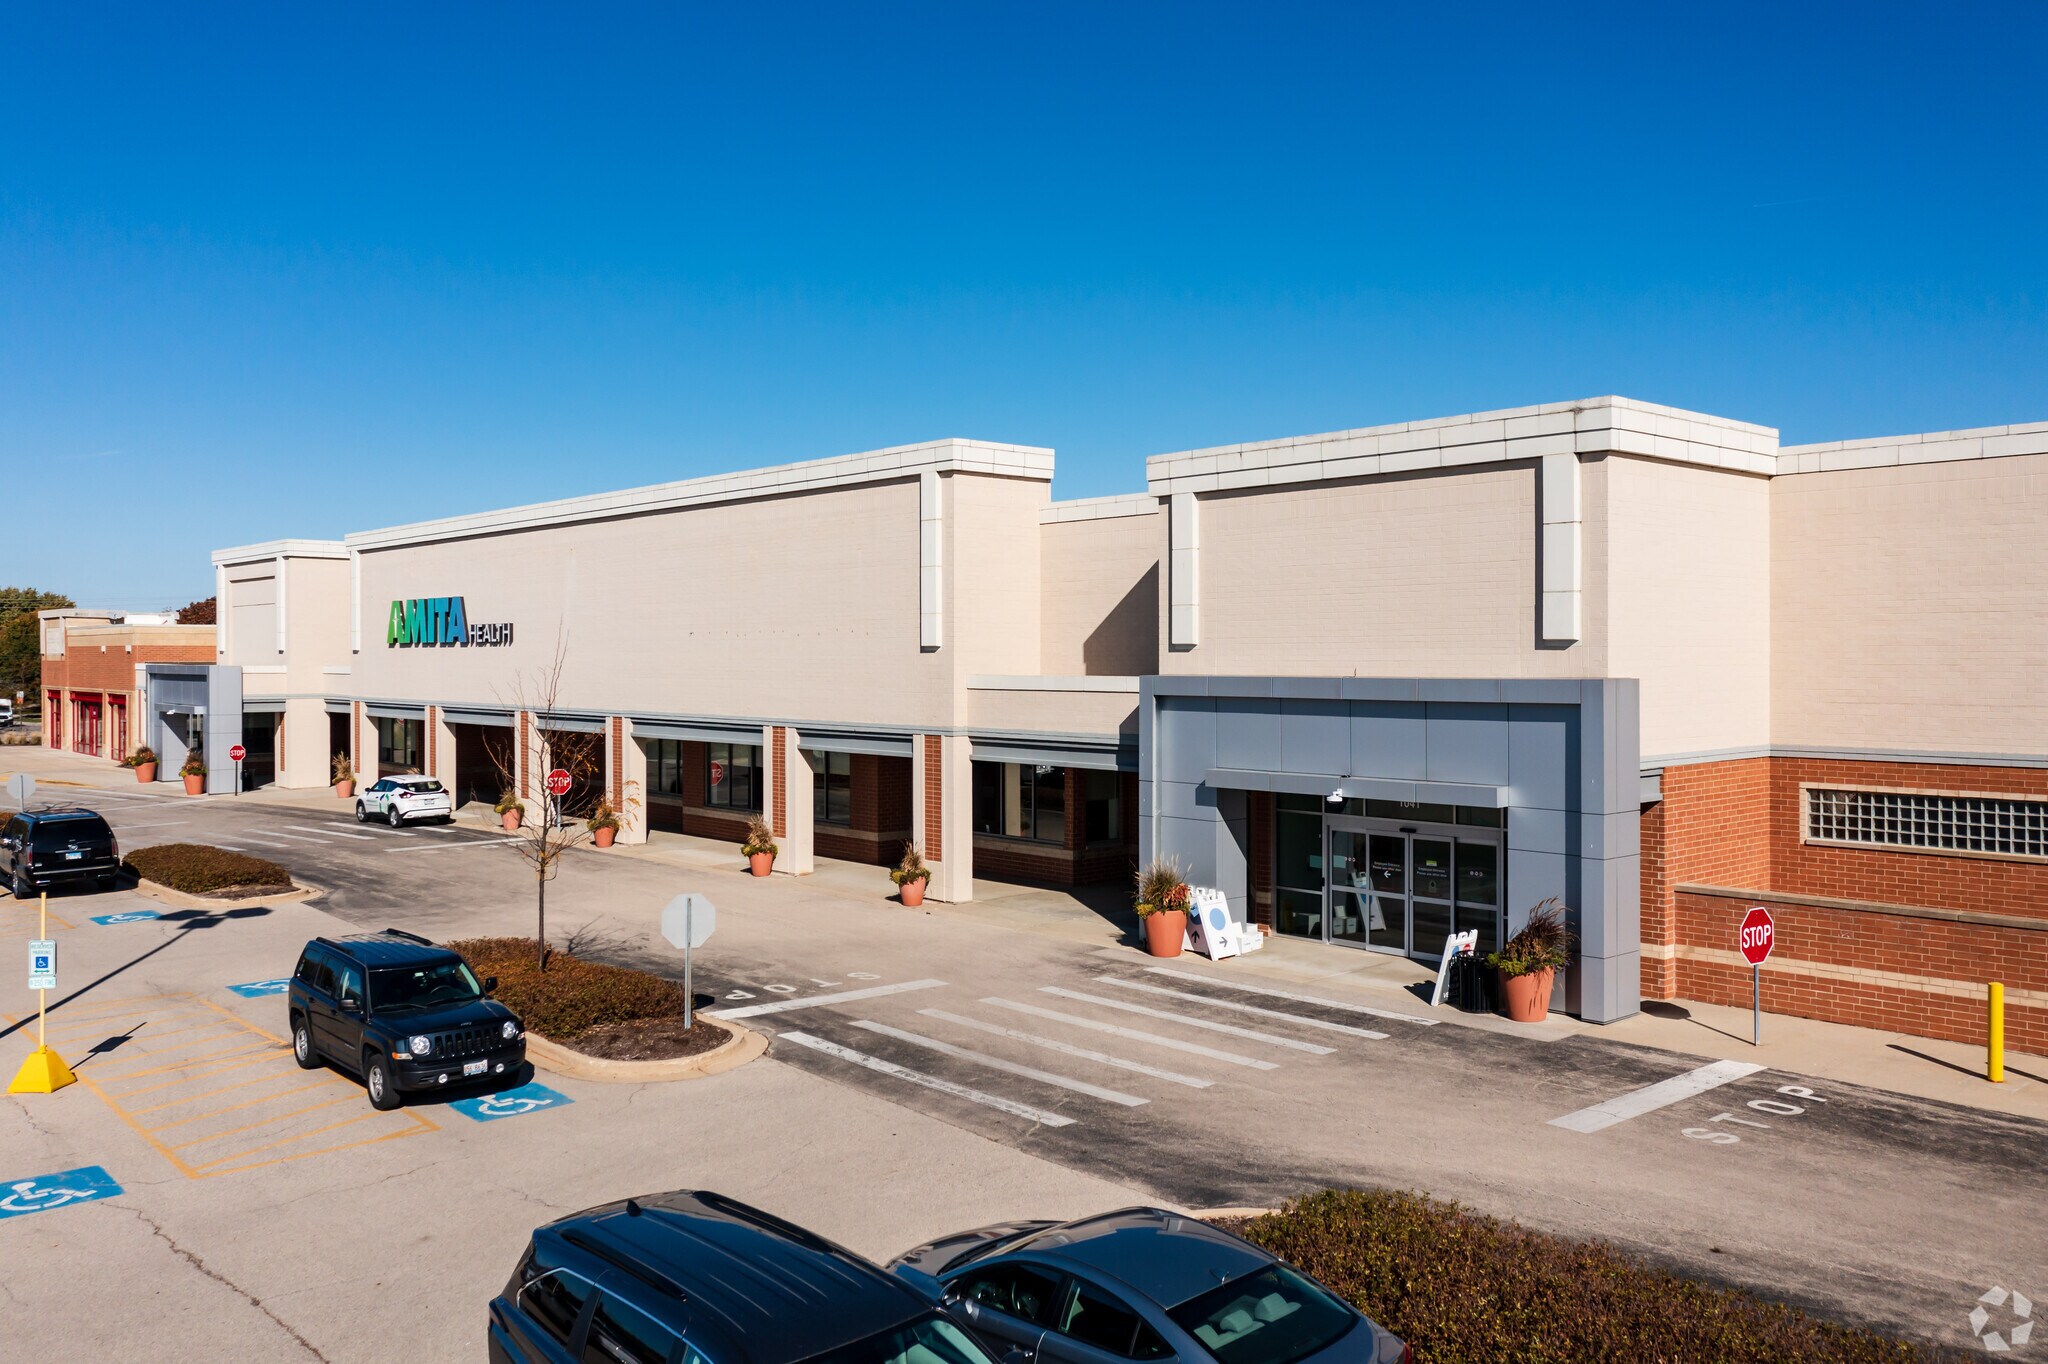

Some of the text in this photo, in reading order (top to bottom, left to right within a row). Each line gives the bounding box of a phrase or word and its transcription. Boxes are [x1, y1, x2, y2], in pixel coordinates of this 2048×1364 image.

[387, 596, 512, 645] AMITA HEALTH
[548, 777, 570, 788] STOP
[1743, 924, 1772, 949] STOP
[725, 972, 881, 1000] STOP
[1681, 1085, 1827, 1144] STOP
